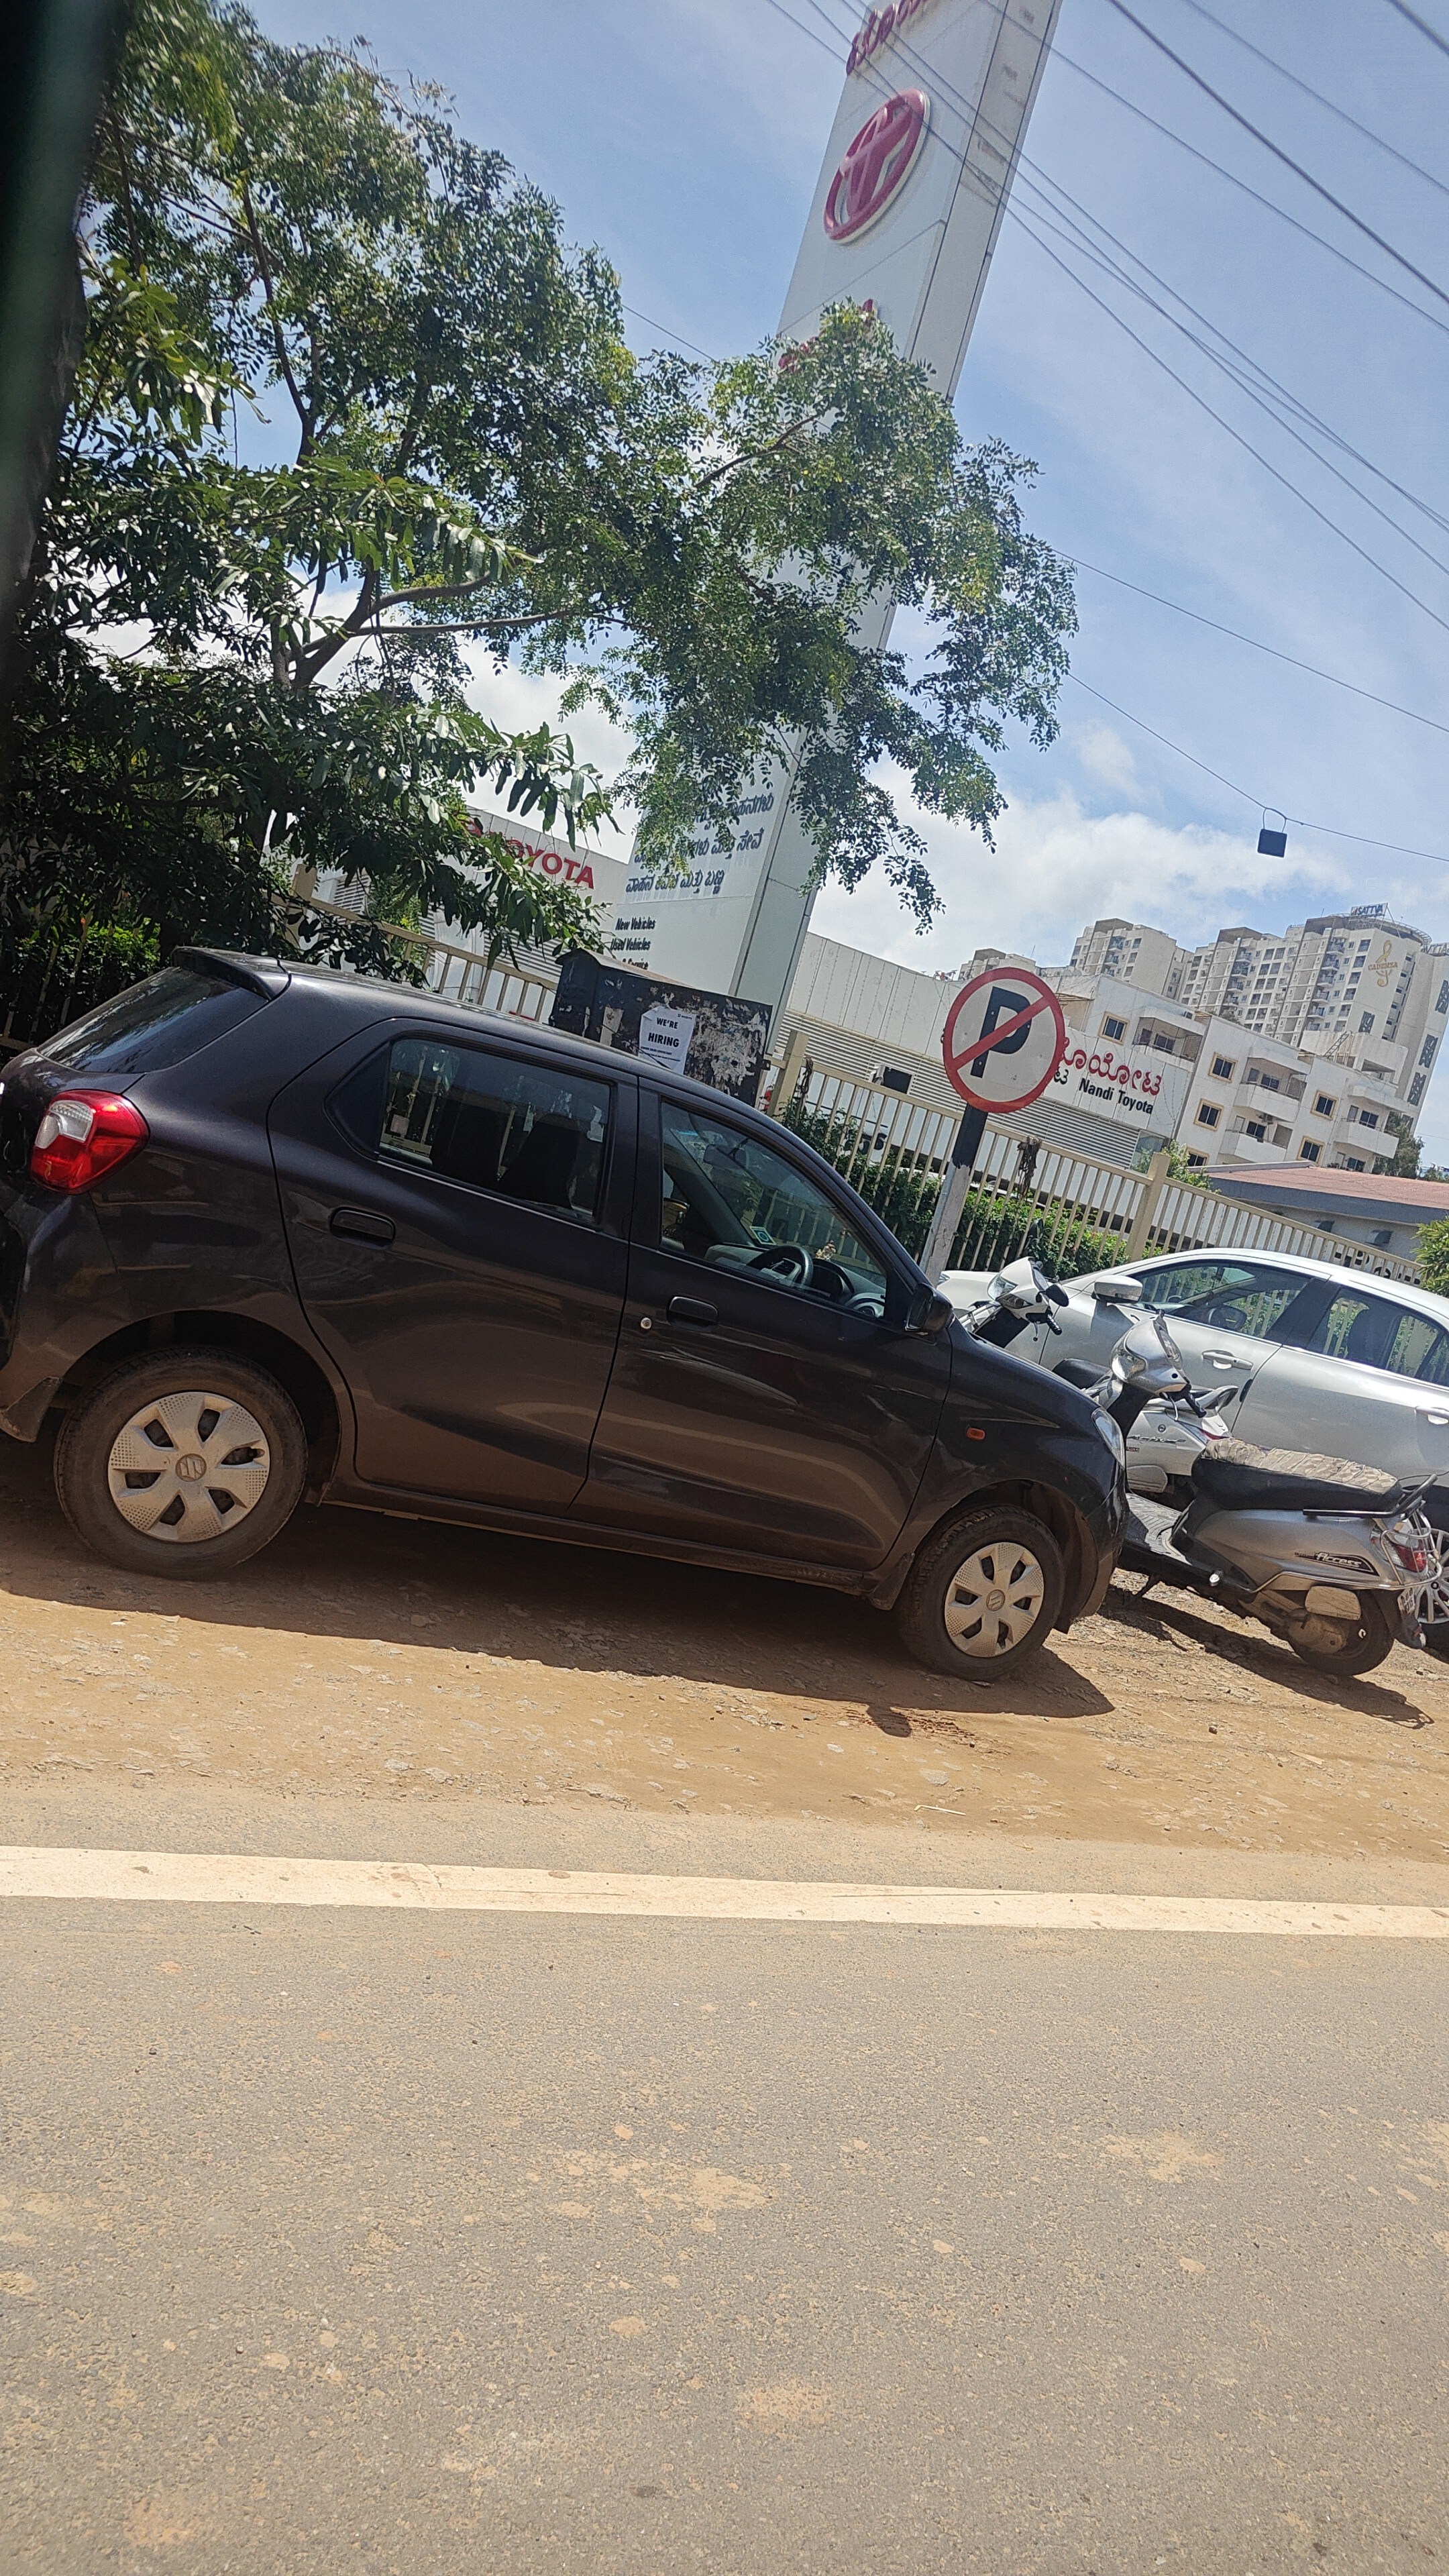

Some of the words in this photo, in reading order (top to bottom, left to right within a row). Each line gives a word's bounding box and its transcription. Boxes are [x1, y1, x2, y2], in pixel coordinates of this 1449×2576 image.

[488, 830, 594, 890] OYOTA
[615, 917, 631, 931] New
[630, 916, 656, 930] Vehicles
[625, 936, 651, 951] Vehicles
[656, 1017, 679, 1029] WE'RE
[647, 1032, 680, 1048] HIRING
[1079, 1078, 1115, 1101] Nandi
[1118, 1090, 1154, 1114] Toyota
[1316, 1552, 1362, 1568] Access
